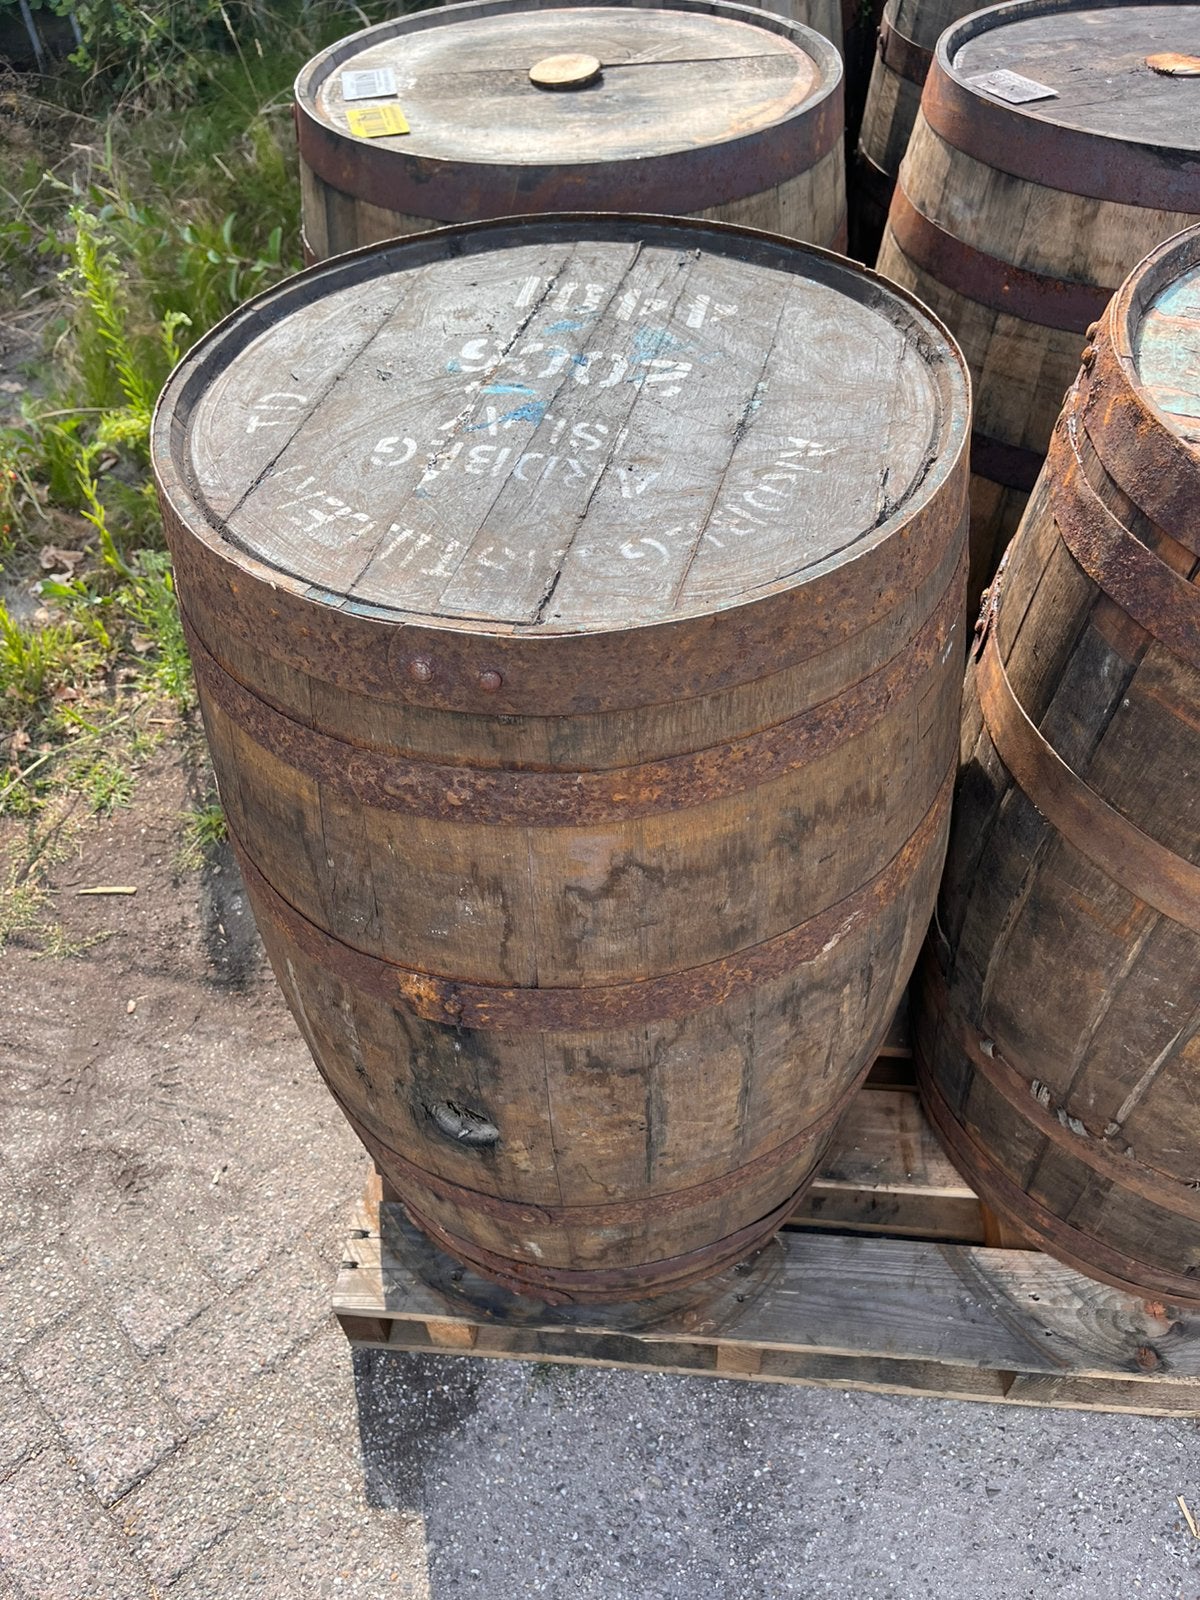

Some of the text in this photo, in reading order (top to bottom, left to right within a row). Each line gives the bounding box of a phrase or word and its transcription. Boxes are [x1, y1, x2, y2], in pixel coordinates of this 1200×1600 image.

[459, 338, 693, 396] 2006
[246, 392, 308, 449] TD
[438, 404, 628, 456] ISLAY
[371, 436, 661, 498] ARDBEG
